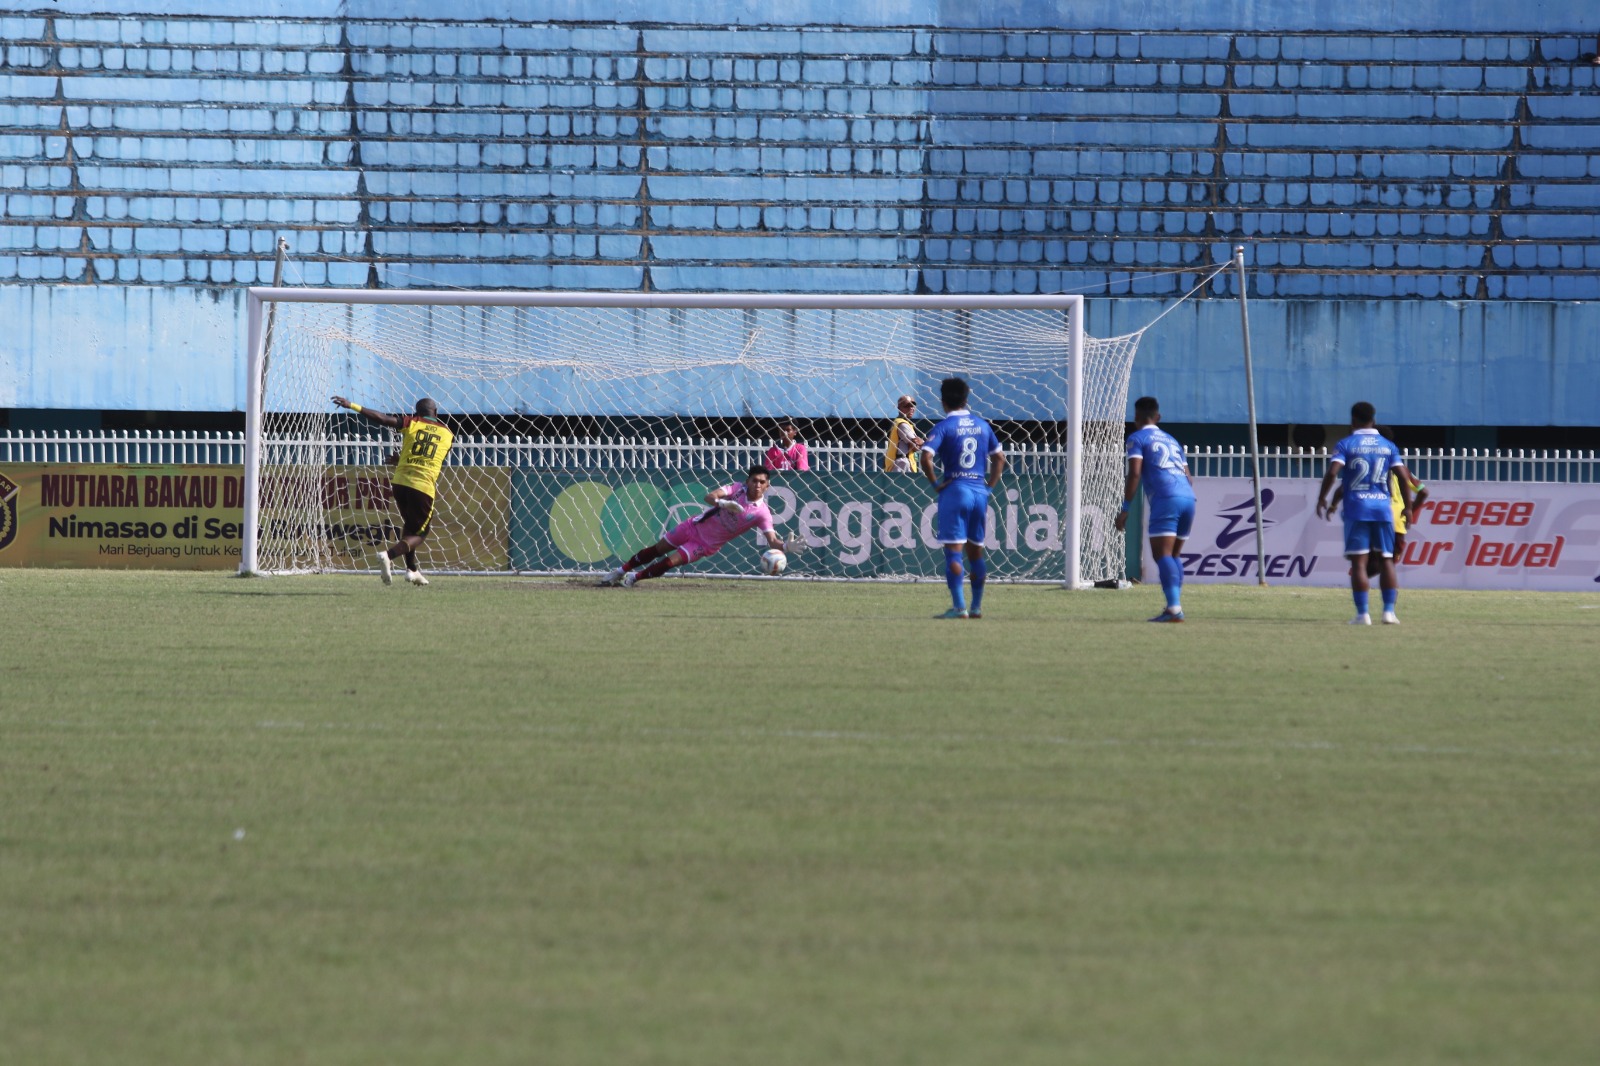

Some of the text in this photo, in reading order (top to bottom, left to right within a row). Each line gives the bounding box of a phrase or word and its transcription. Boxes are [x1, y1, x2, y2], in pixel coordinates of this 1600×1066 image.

[412, 429, 441, 460] 86
[959, 437, 978, 469] 8
[1152, 441, 1186, 472] 25
[1350, 457, 1389, 492] 24
[41, 474, 139, 508] MUTIARA
[144, 474, 217, 509] BAKAU
[49, 514, 167, 539] Nimasao
[173, 515, 198, 539] di
[99, 544, 124, 555] Mari
[127, 544, 181, 558] Berjuang
[184, 545, 221, 556] Untuk
[1465, 534, 1565, 567] level
